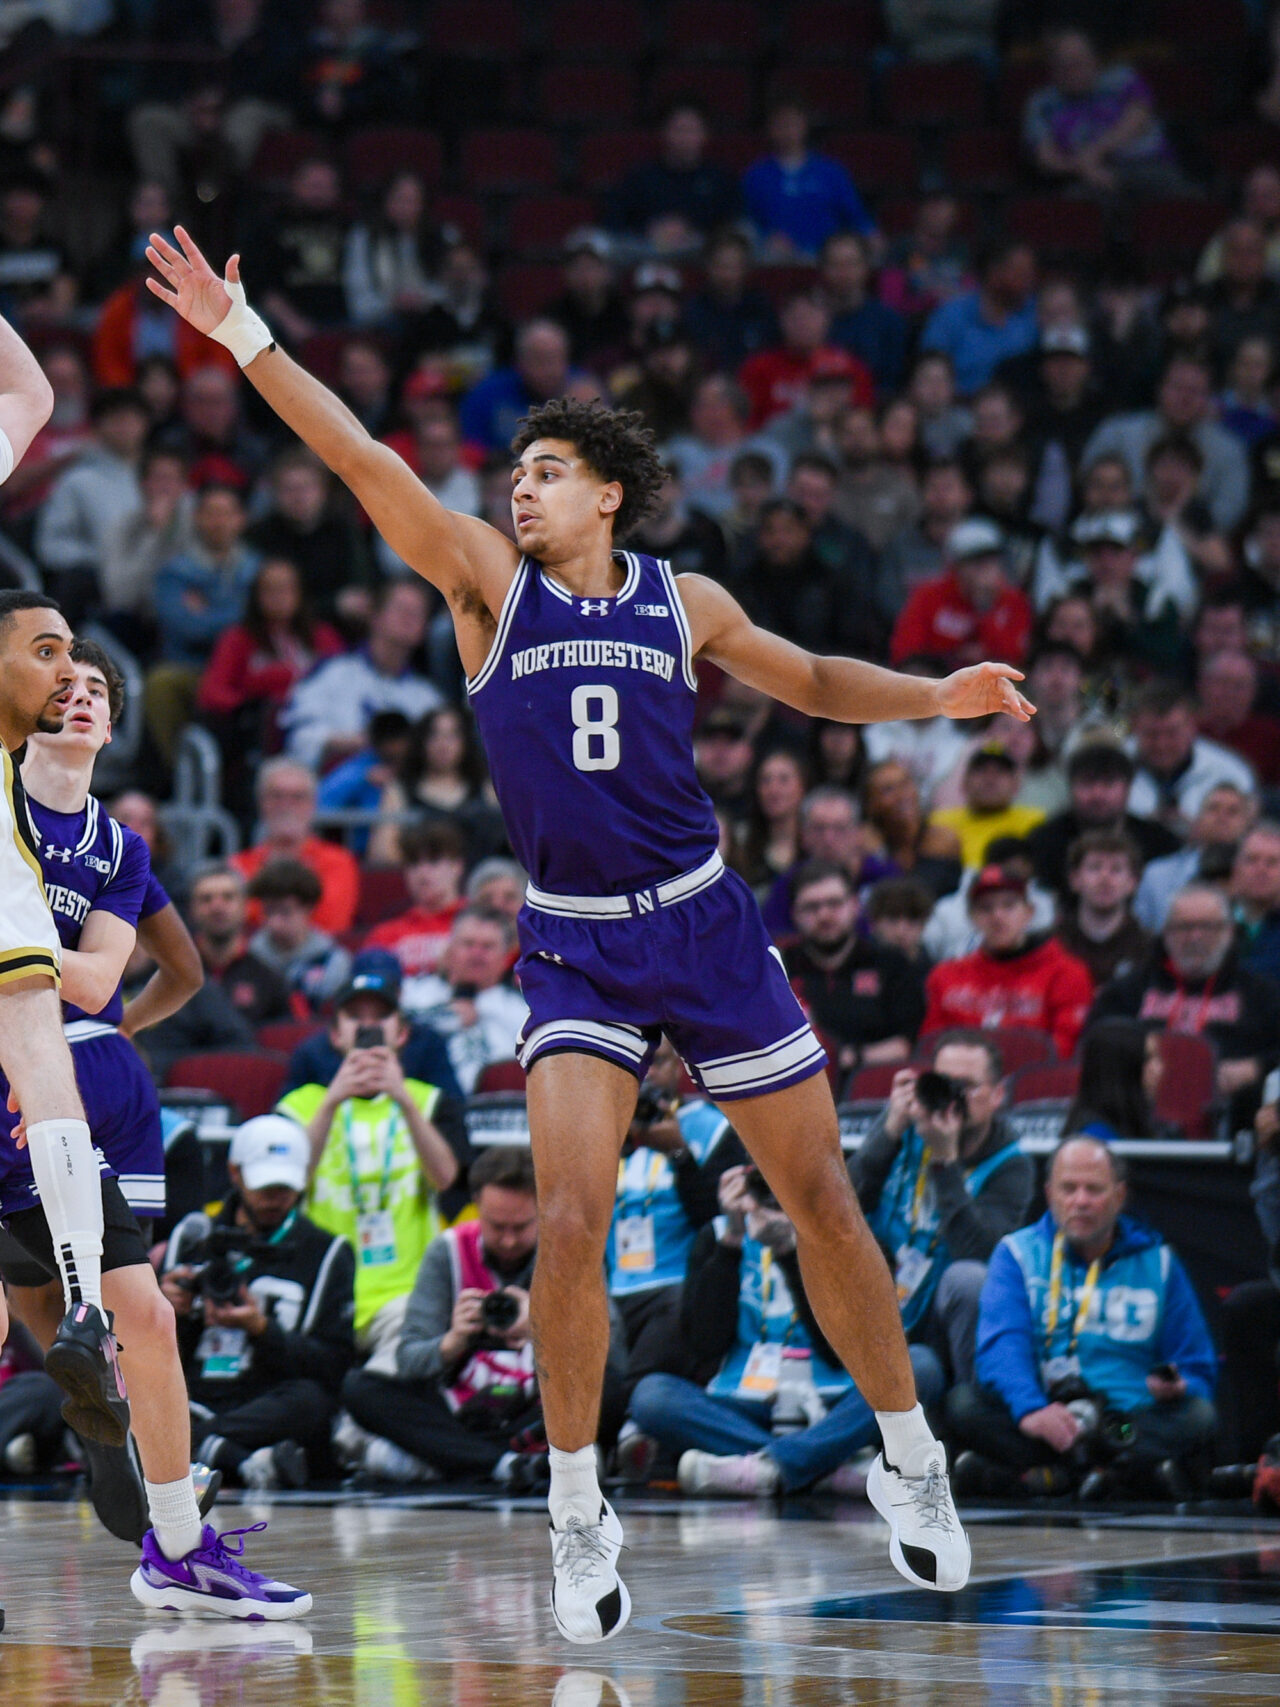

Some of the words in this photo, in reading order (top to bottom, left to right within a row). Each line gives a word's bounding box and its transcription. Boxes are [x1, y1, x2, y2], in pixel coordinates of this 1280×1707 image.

[511, 640, 676, 683] NORTHWESTERN
[571, 684, 620, 772] 8
[634, 889, 655, 915] N
